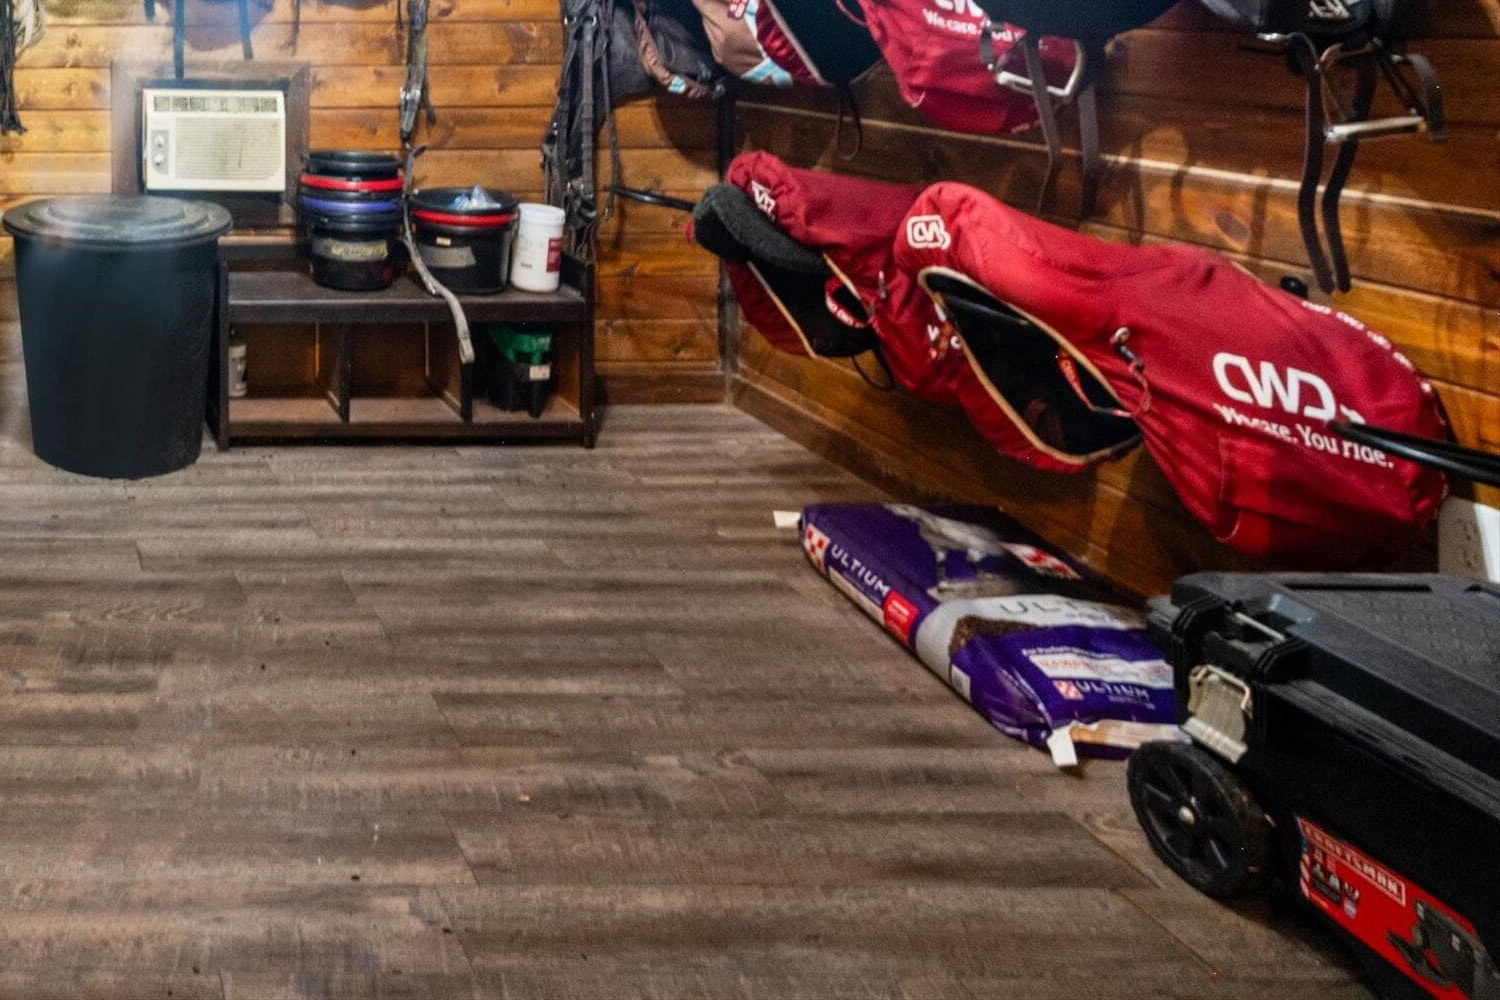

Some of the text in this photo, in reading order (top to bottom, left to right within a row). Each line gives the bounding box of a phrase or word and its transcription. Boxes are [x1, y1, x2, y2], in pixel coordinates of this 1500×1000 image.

[1212, 352, 1337, 423] CWD
[1296, 422, 1339, 455] You
[831, 544, 891, 597] ULTIUM
